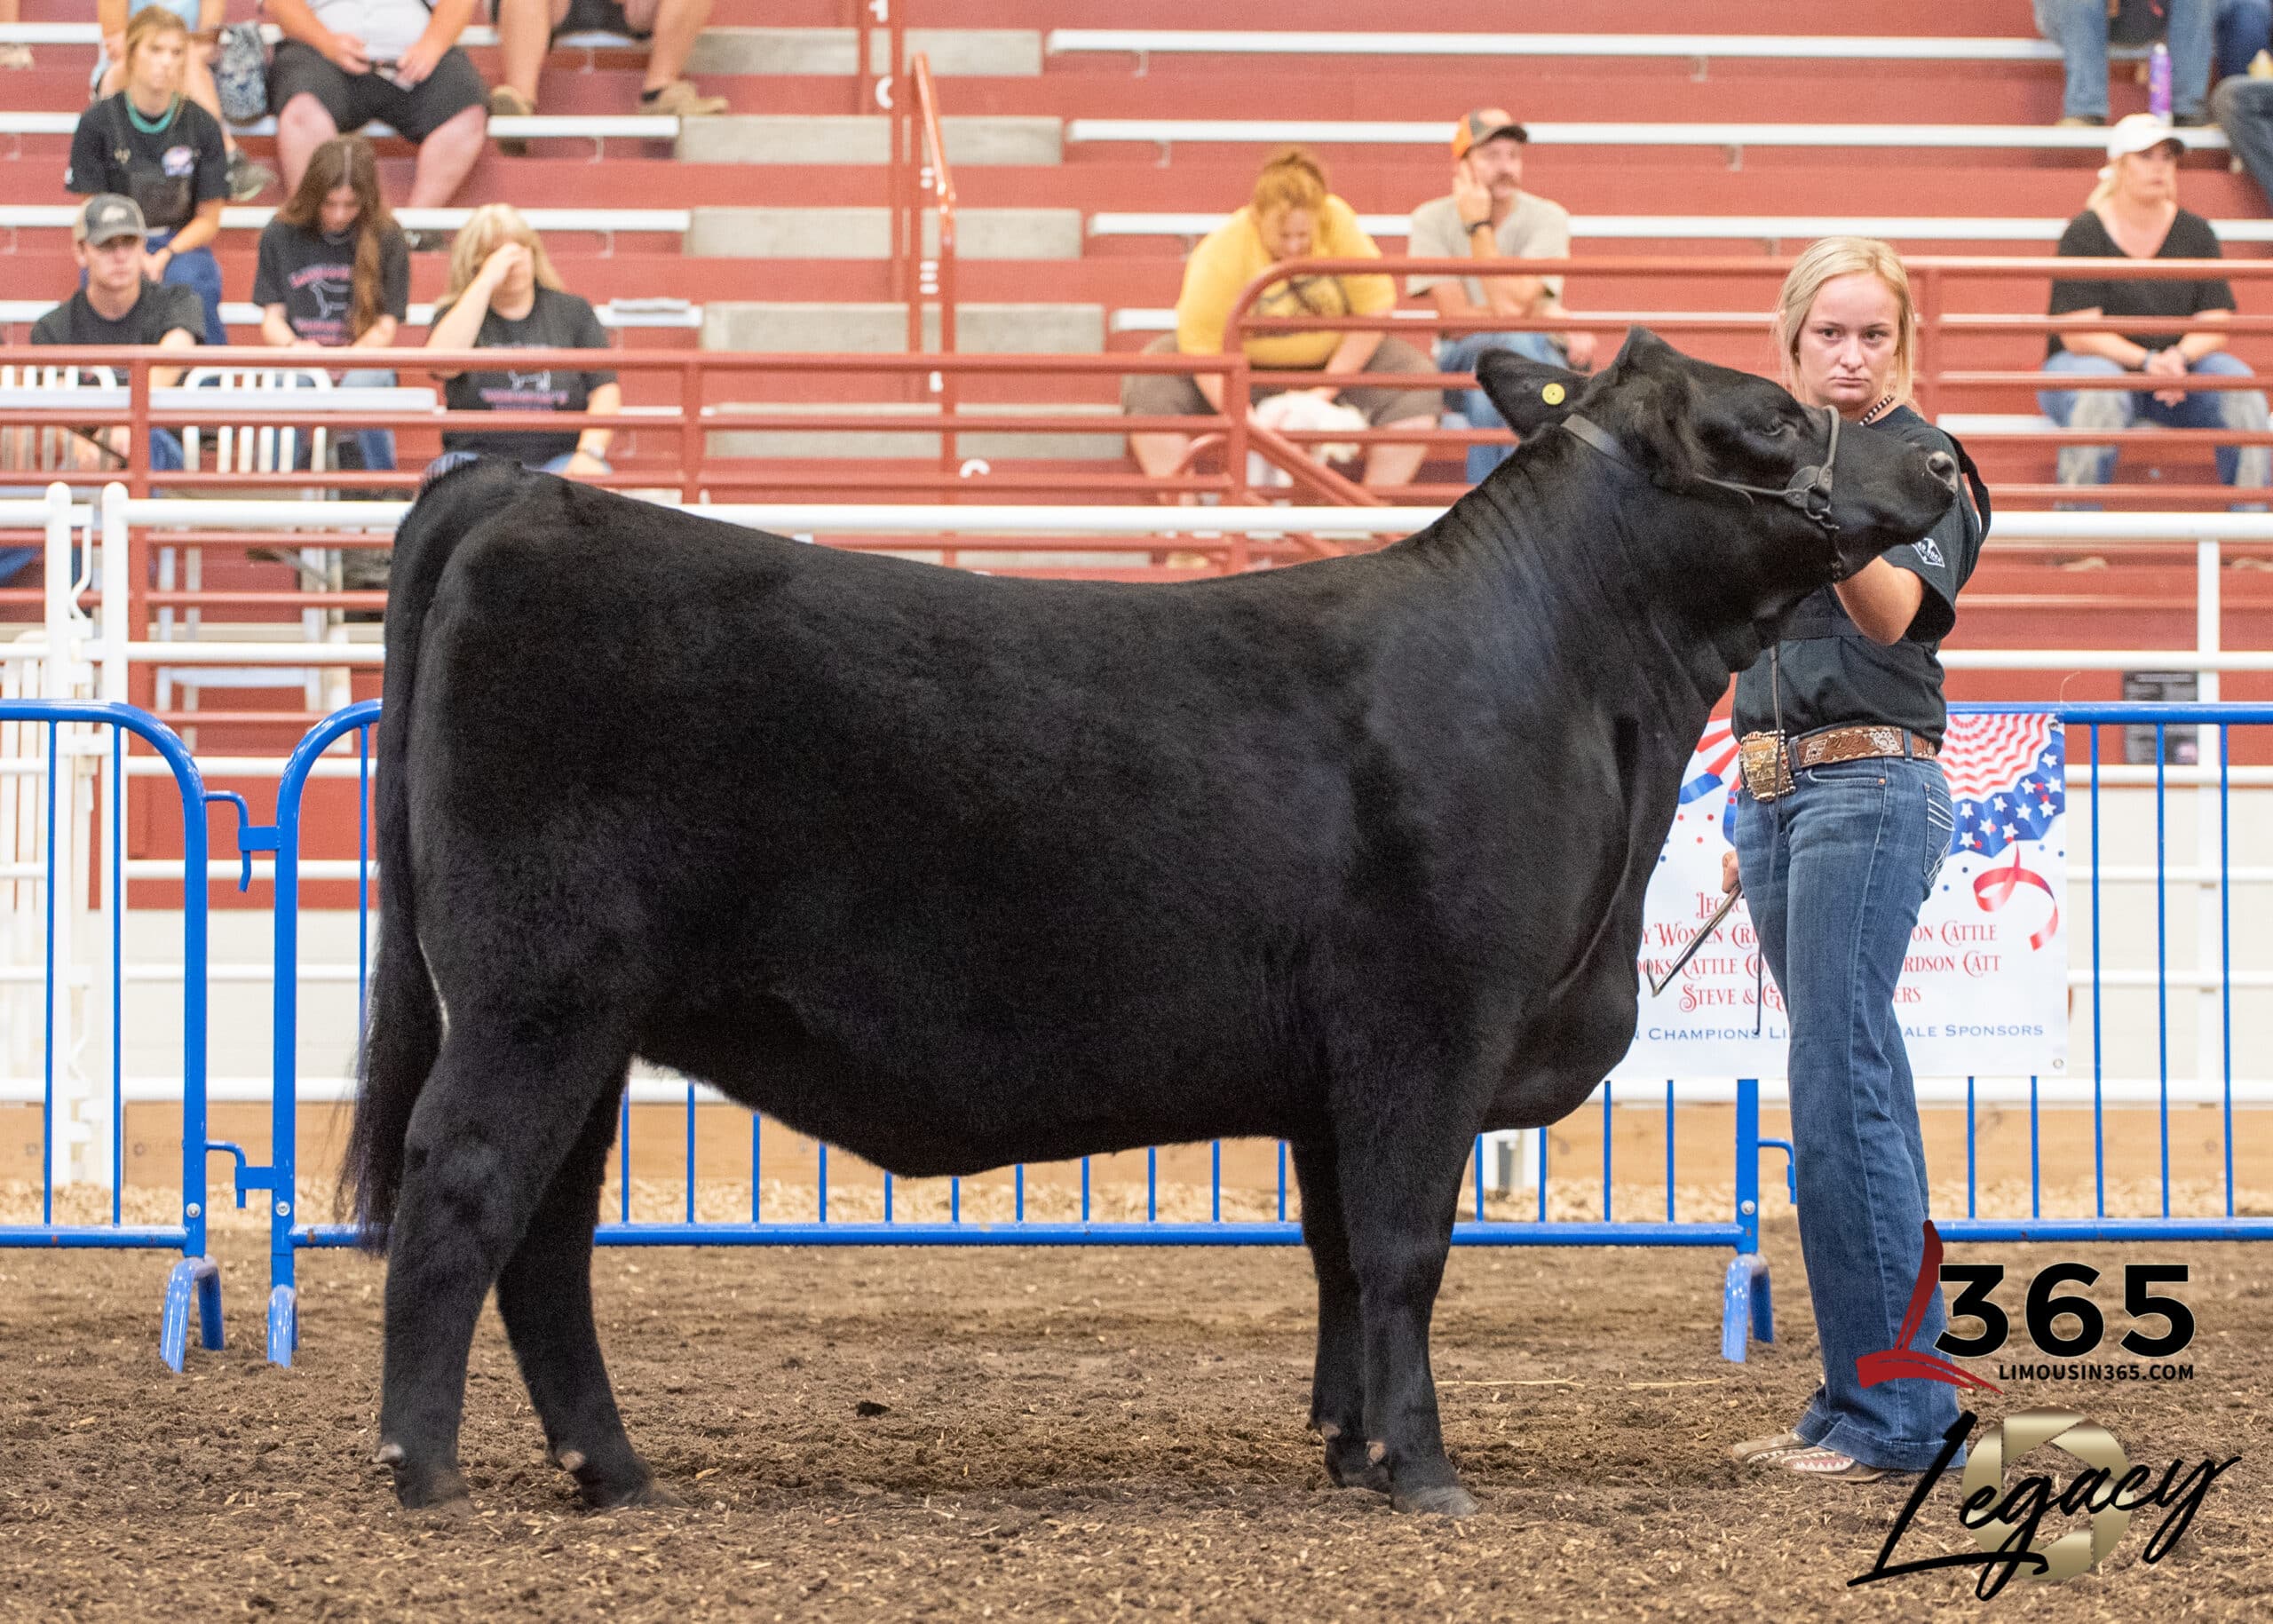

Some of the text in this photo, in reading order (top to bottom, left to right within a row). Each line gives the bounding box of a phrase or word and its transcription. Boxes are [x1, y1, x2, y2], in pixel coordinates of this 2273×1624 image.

[1941, 919, 1999, 947] CATTLE
[1903, 955, 1955, 973] RDSON
[1679, 983, 1737, 1012] STEVE
[1743, 989, 1755, 1005] &
[1904, 1026, 1937, 1038] ALE
[1945, 1024, 2044, 1037] SPONSORS
